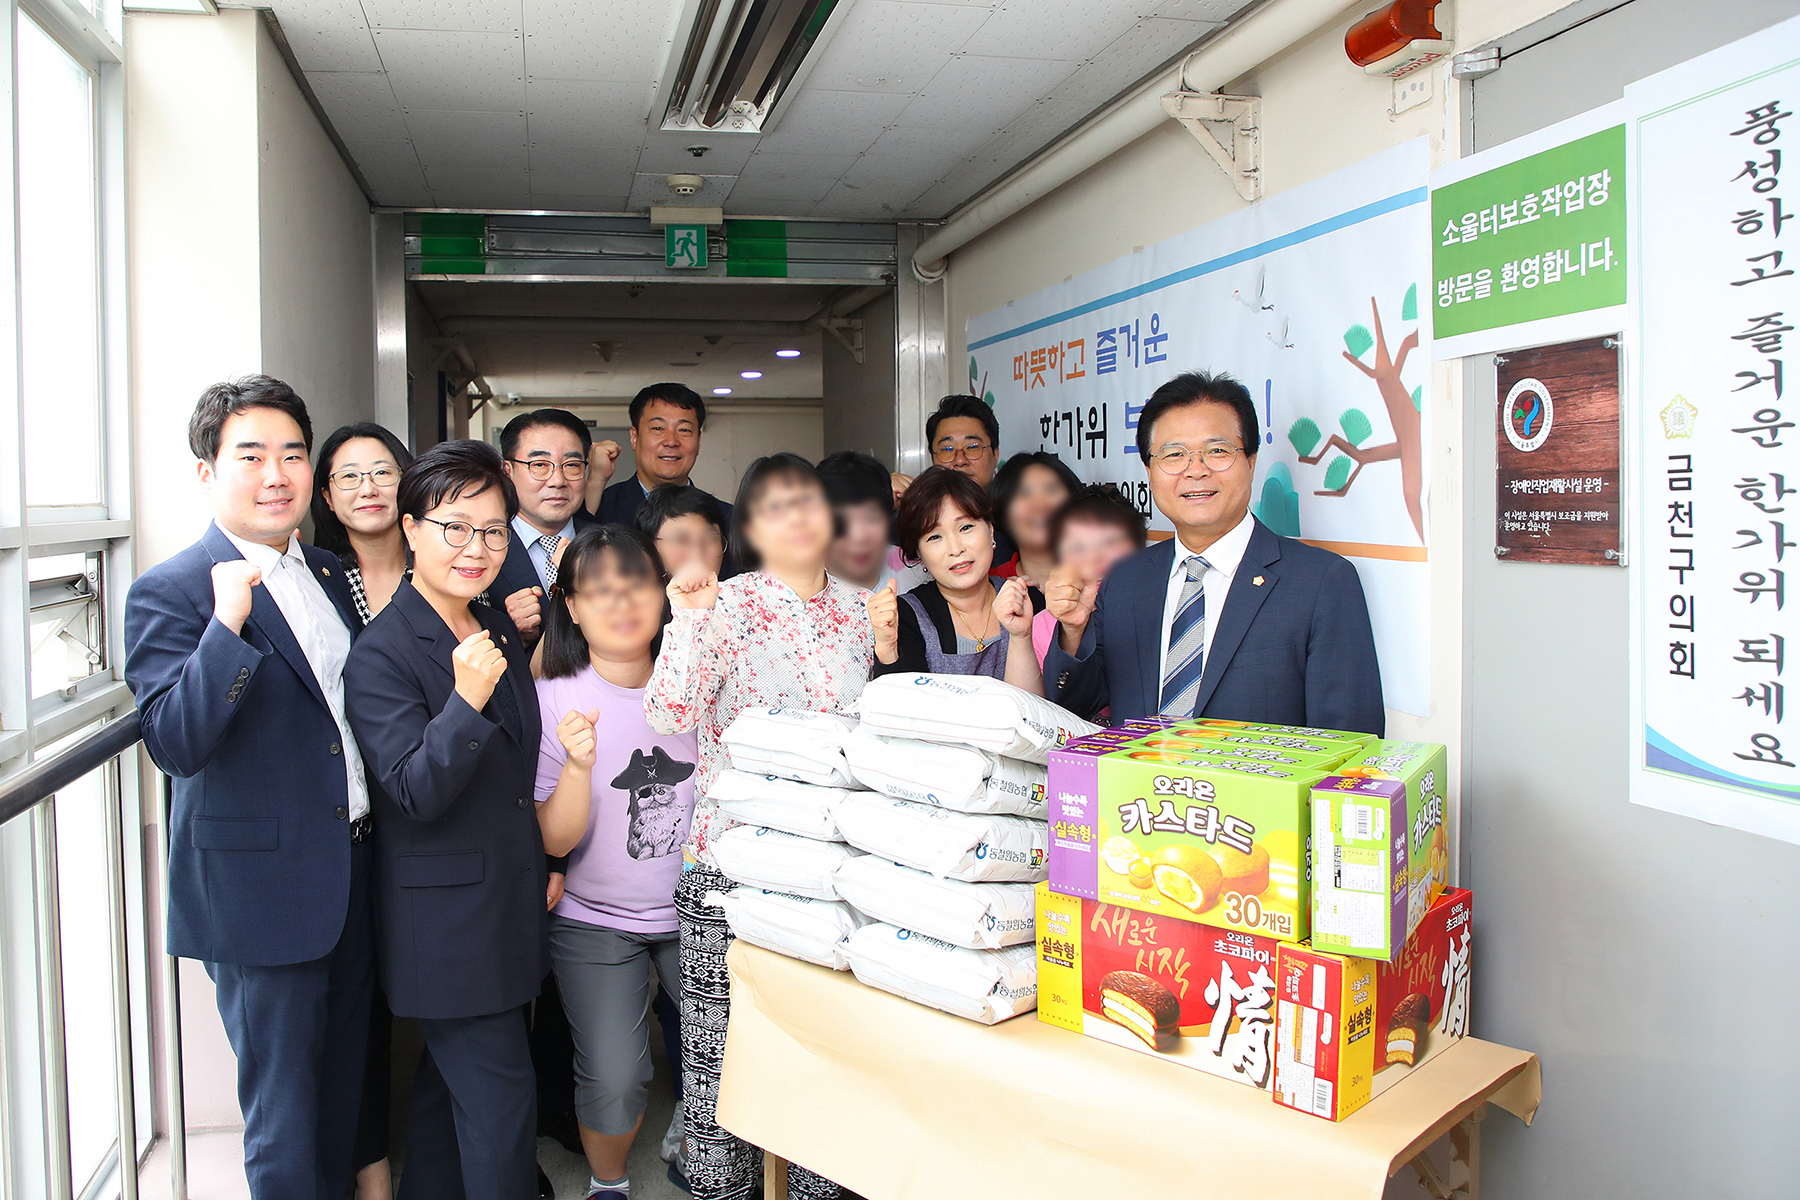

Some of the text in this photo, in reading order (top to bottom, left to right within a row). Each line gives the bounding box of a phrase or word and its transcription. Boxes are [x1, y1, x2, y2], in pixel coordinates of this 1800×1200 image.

[1441, 168, 1612, 247] 소울터보호작업장
[1437, 237, 1619, 308] 방문을 환영합니다.
[1013, 312, 1168, 392] 따뜻하고 즐거운
[1039, 402, 1108, 461] 한가위
[1729, 100, 1797, 768] 풍성하고 즐거운 한가위 되세요
[1510, 477, 1602, 495] 장애인직업재활시설 운영
[1667, 454, 1695, 680] 금천구의회
[1153, 775, 1216, 802] 오리온
[1419, 770, 1435, 801] 오리온
[1054, 820, 1092, 843] 실속형
[1118, 797, 1256, 856] 카스타드
[1413, 792, 1443, 855] 카스타드
[989, 848, 1027, 864] 동철원농협
[1090, 903, 1158, 946] 새로운
[1226, 893, 1291, 935] 30개입
[1446, 908, 1470, 933] 초코파이
[1041, 936, 1075, 960] 실속형
[1214, 939, 1270, 966] 초코파이
[1226, 932, 1254, 947] 오리온
[1135, 947, 1191, 999] 시작
[1408, 944, 1437, 997] 시작
[1347, 1004, 1373, 1035] 실속형
